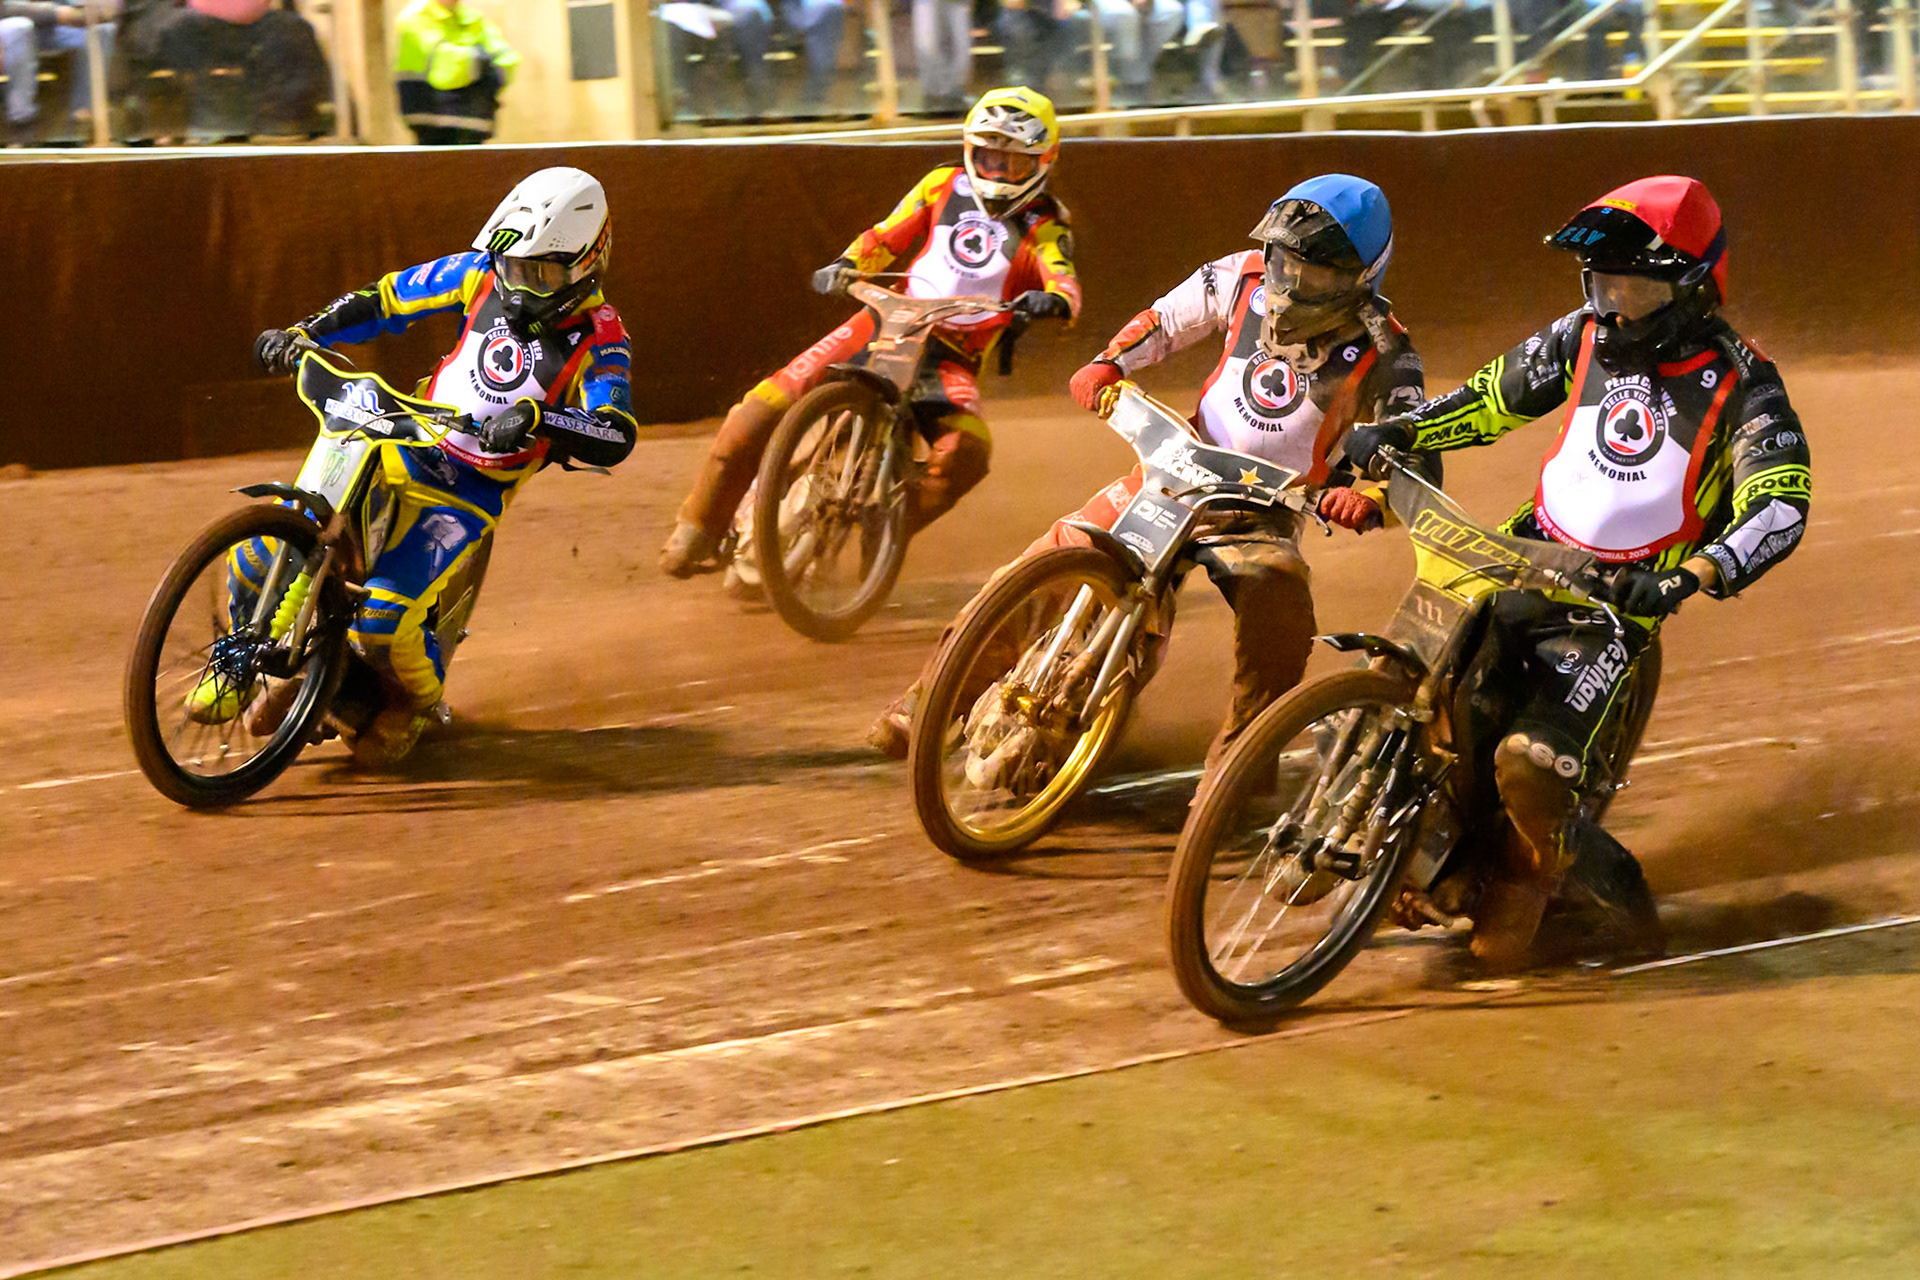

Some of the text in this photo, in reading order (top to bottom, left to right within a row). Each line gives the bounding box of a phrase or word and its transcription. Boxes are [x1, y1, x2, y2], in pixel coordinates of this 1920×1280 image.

[1556, 226, 1607, 246] FLY
[566, 331, 582, 346] 4
[1342, 345, 1360, 363] 6
[469, 368, 510, 405] MEMORIAL
[1700, 369, 1718, 389] 9
[1233, 396, 1285, 433] MEMORIAL
[1604, 390, 1665, 432] BELLE VUE ACES
[1587, 449, 1648, 482] MEMORIAL
[1747, 474, 1802, 499] ROCK
